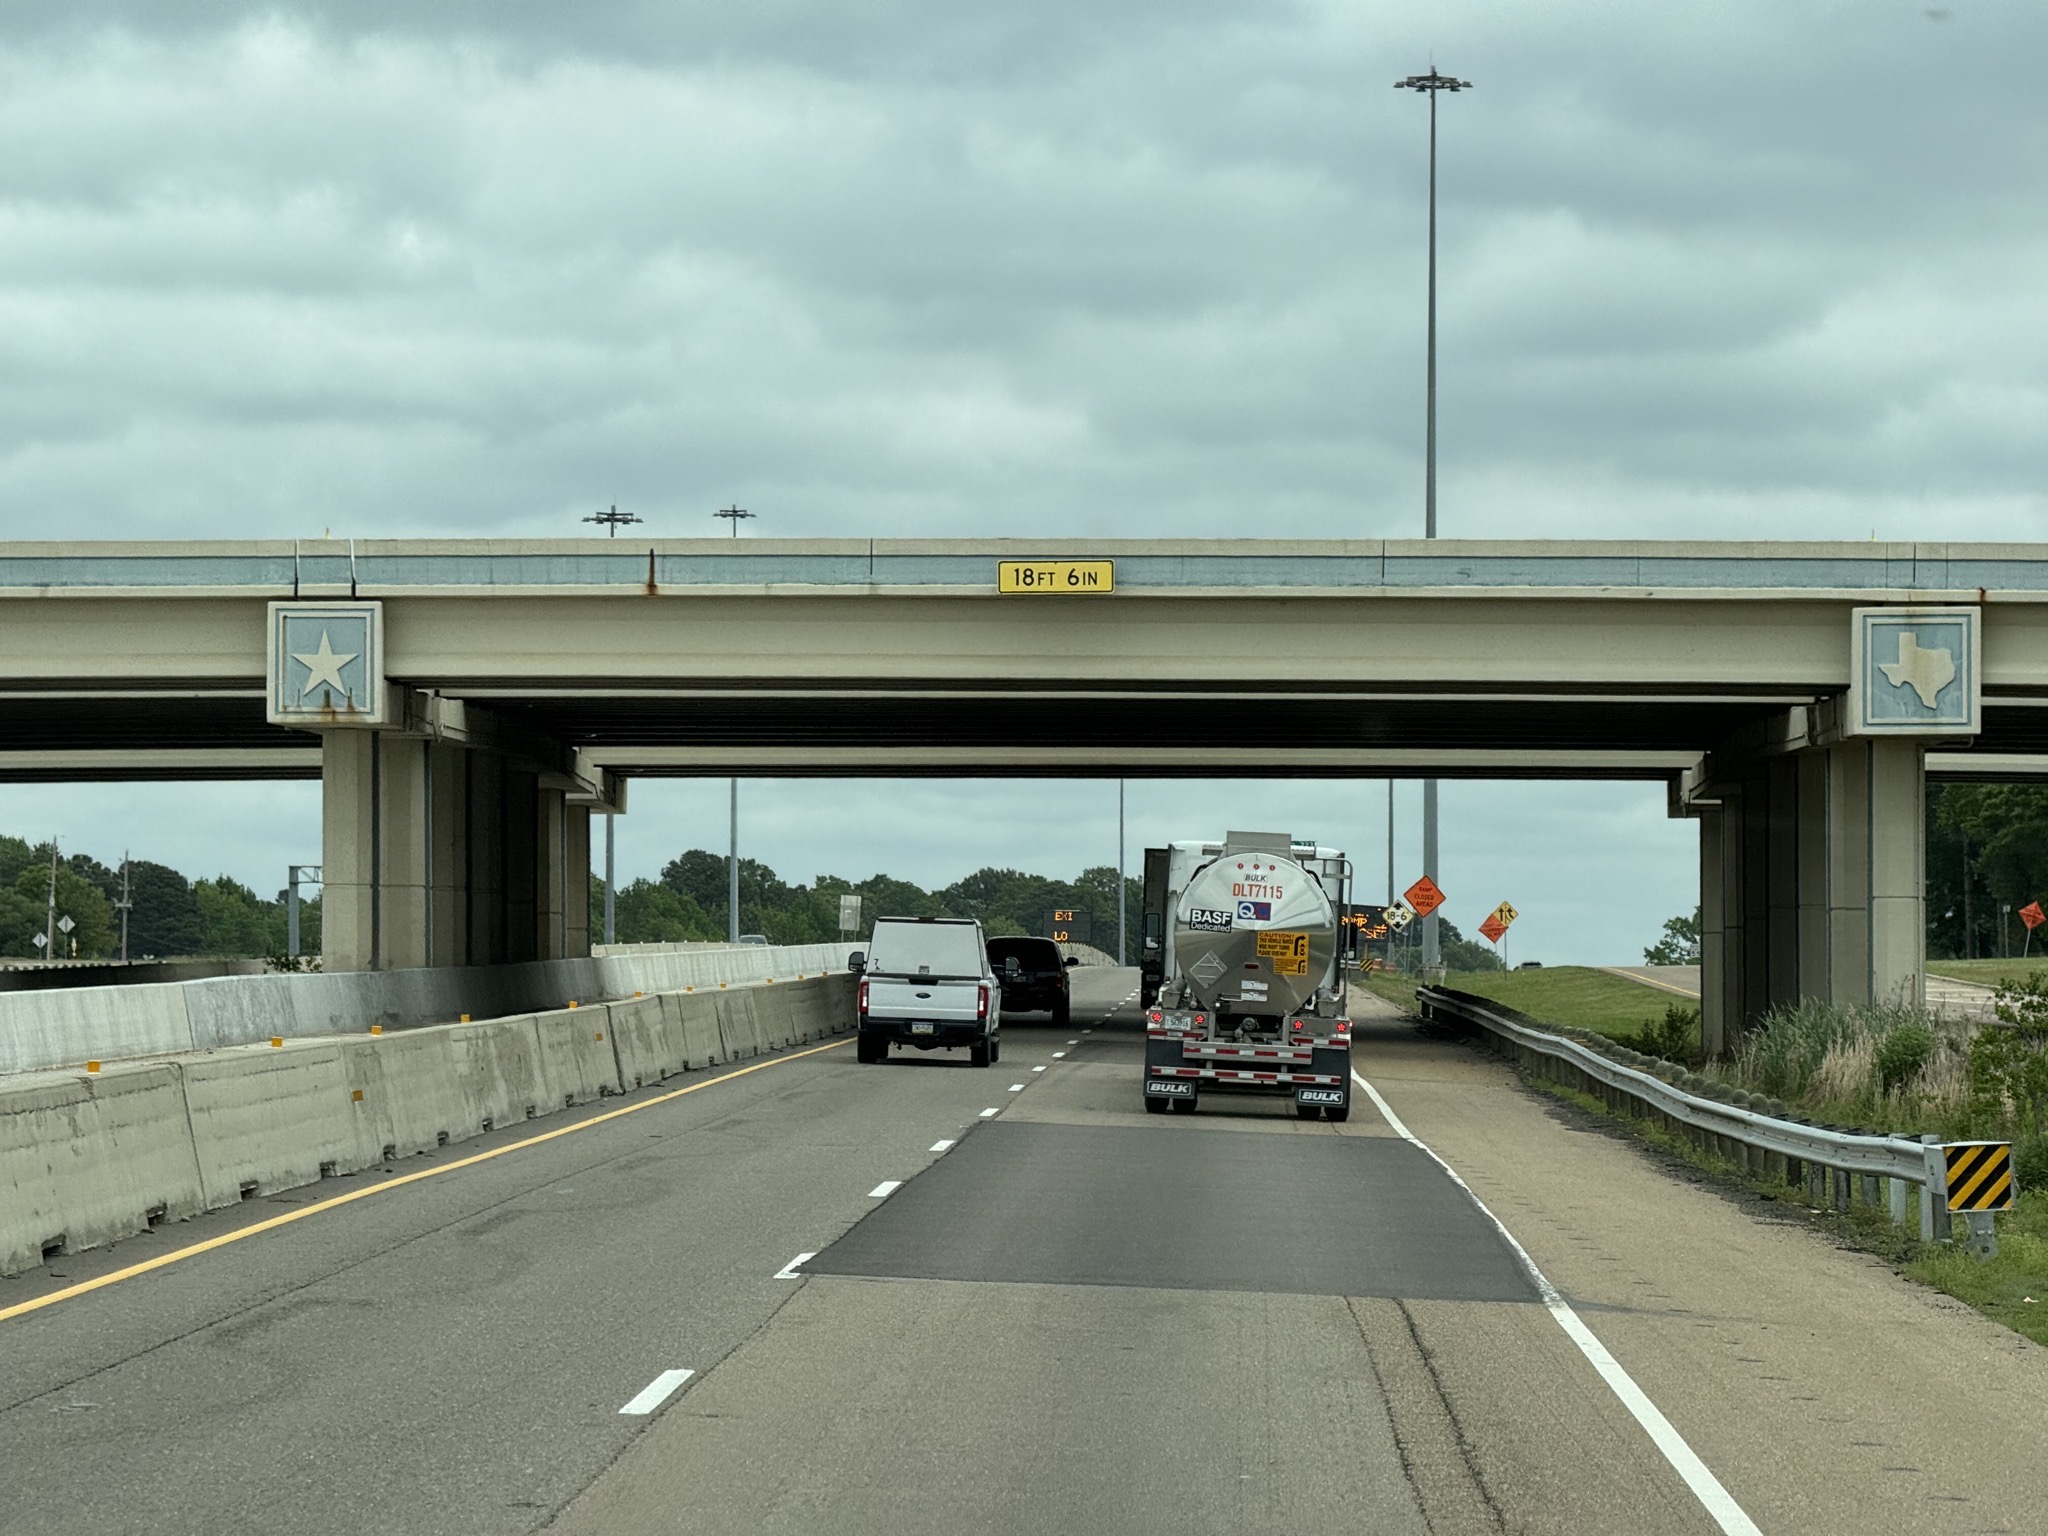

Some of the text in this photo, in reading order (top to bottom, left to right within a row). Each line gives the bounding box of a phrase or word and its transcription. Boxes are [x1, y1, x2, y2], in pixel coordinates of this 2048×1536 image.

[1067, 567, 1098, 586] 6IN
[1245, 874, 1267, 882] BULK
[1232, 883, 1283, 900] DLT7115
[1192, 909, 1231, 924] BASF
[1190, 921, 1231, 933] Dedicated
[1150, 1083, 1190, 1093] BULK
[1302, 1091, 1341, 1101] BULK
